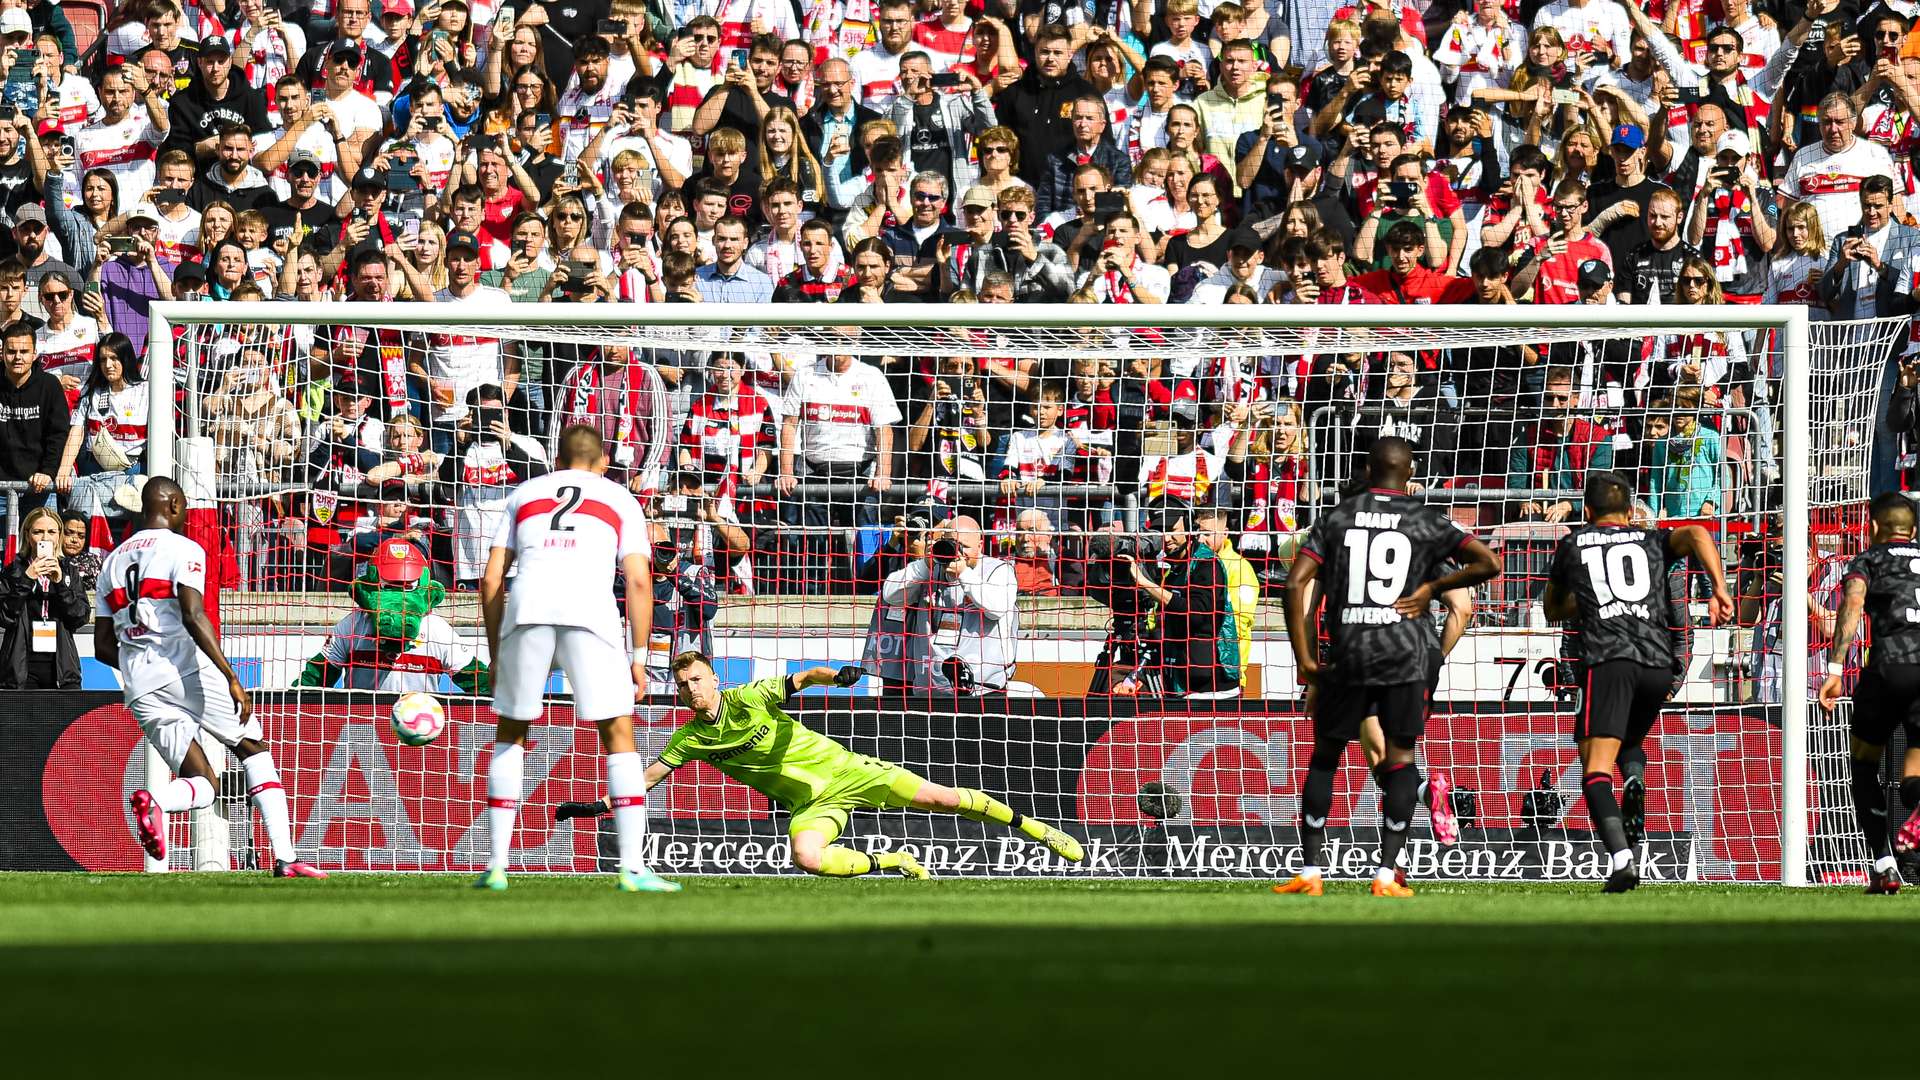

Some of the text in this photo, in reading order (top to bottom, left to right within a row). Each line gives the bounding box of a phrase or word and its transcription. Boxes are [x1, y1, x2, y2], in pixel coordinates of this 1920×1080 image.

[550, 486, 582, 531] 2
[1354, 511, 1402, 529] DIABY
[1343, 529, 1413, 606] 19
[1580, 542, 1652, 607] 10
[125, 562, 140, 625] 9
[868, 635, 900, 657] FOT
[921, 655, 946, 677] FO
[708, 722, 771, 763] Barmenia
